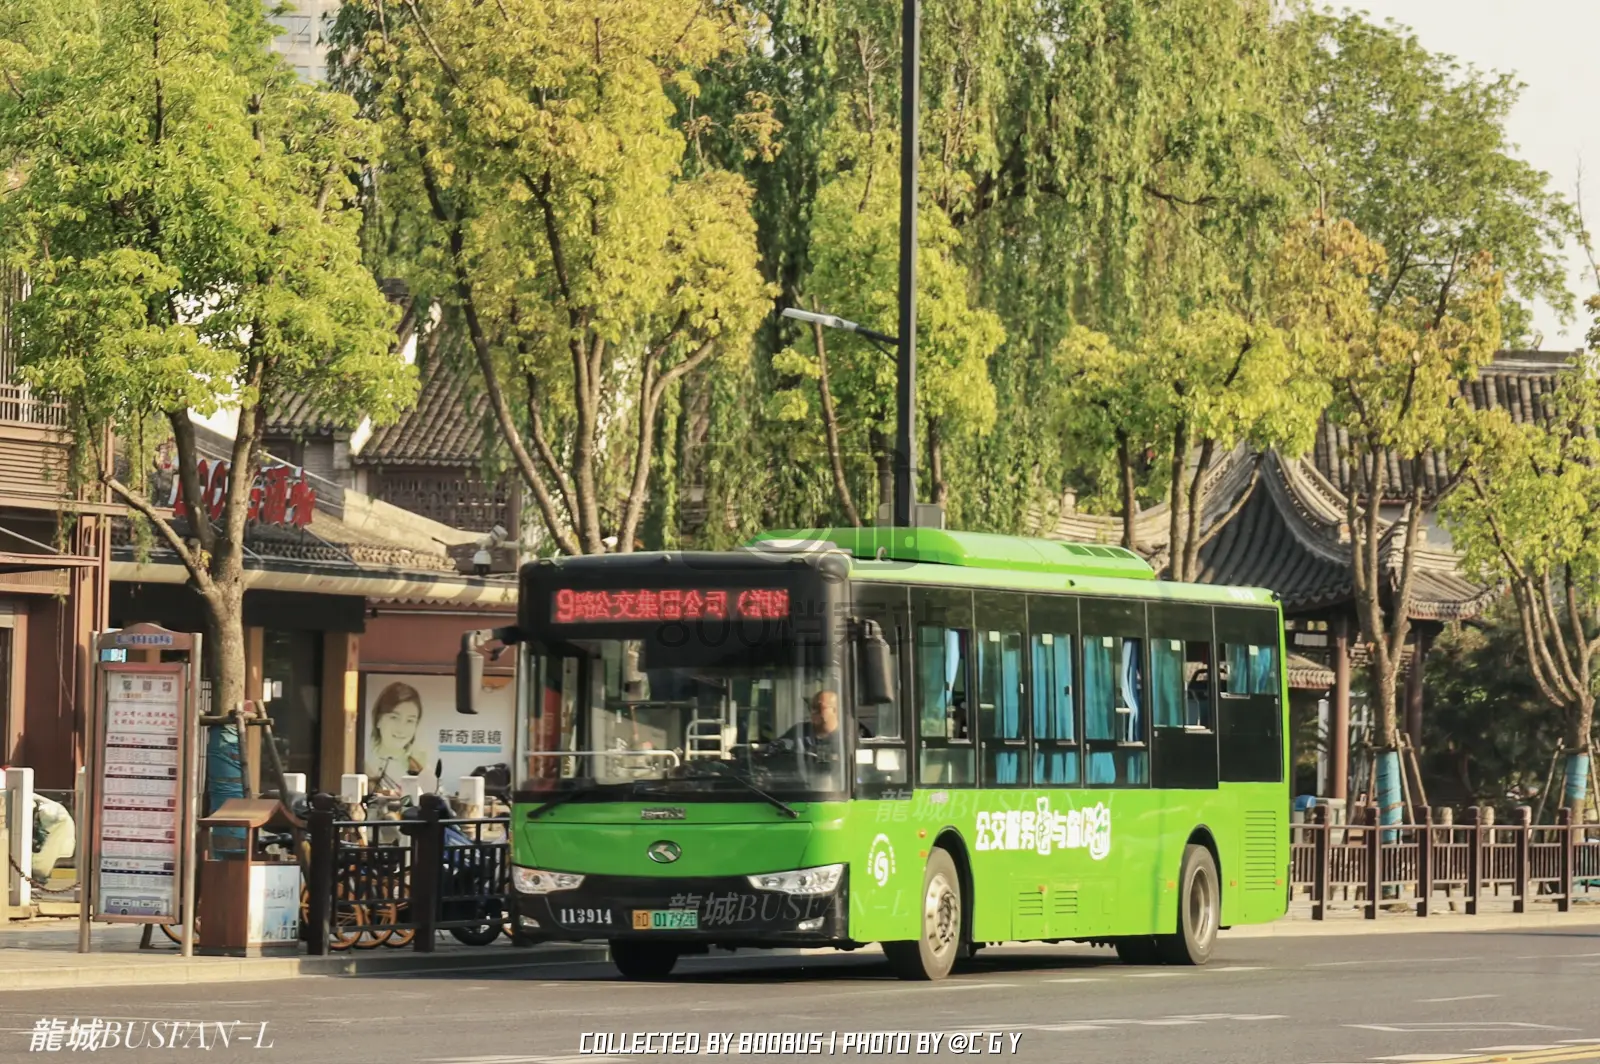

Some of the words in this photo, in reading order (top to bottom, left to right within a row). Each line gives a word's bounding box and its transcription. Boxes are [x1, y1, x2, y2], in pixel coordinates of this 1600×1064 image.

[439, 729, 502, 744] 新奇眼镜
[560, 908, 612, 924] 113914
